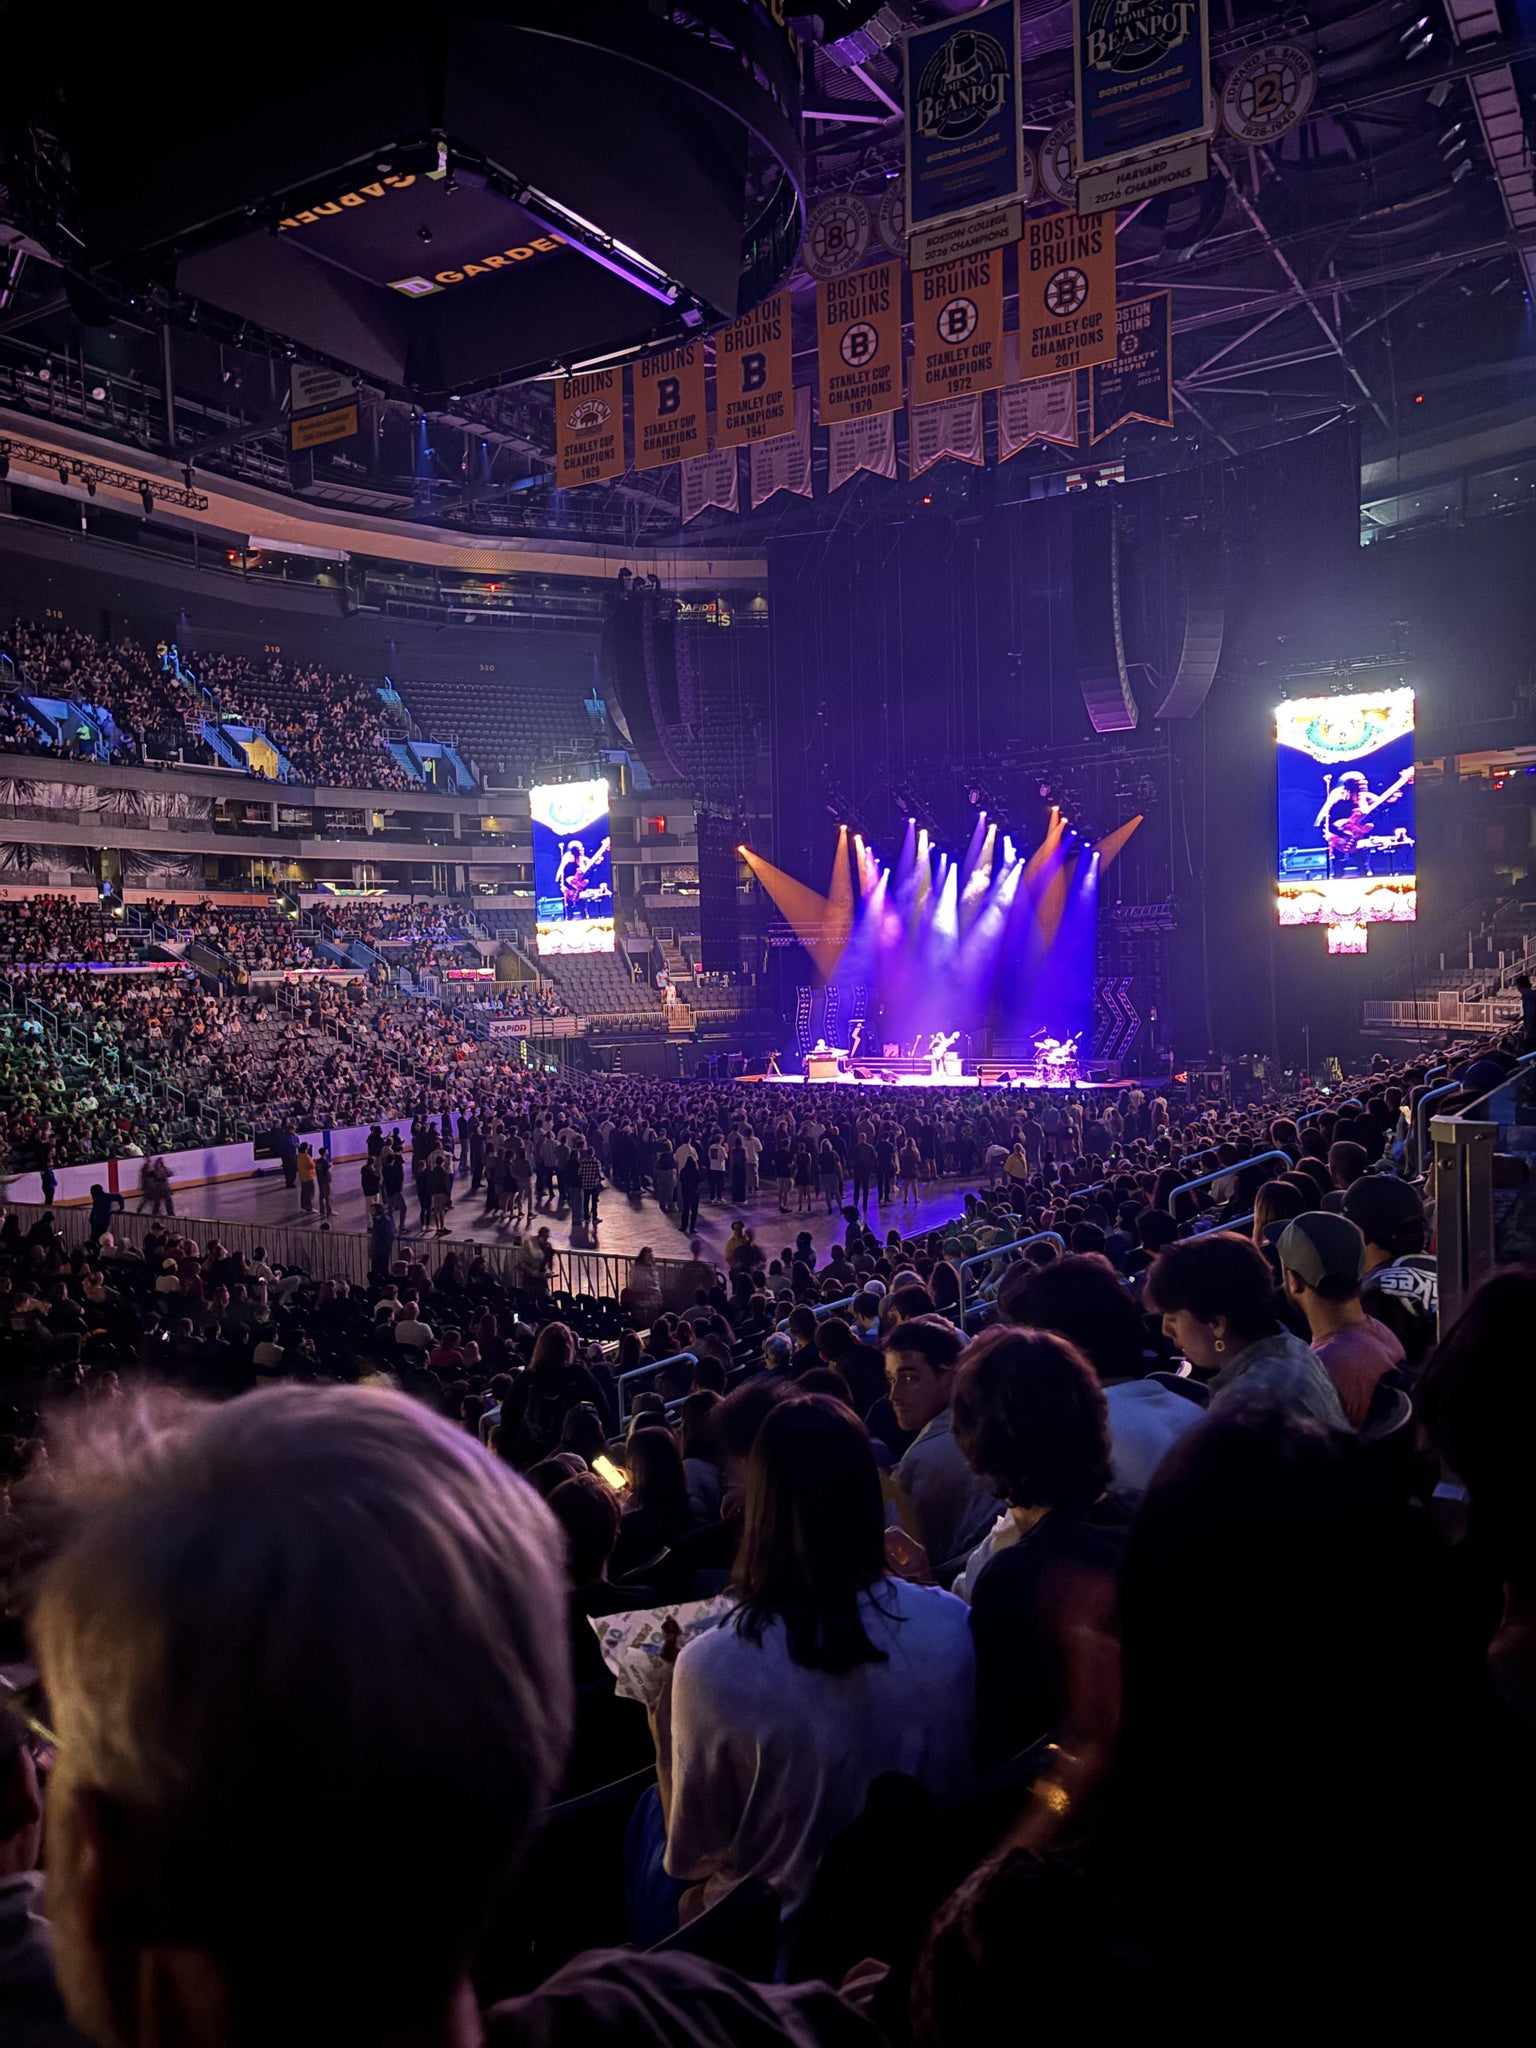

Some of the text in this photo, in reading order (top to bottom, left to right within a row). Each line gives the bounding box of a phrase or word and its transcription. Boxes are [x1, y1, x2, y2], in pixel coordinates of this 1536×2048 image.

[1085, 3, 1195, 69] BEANPOT
[916, 74, 1011, 133] BEANPOT
[1259, 80, 1277, 108] 2
[1095, 167, 1192, 205] 2026 CHAMPIONS
[1116, 161, 1168, 185] HARVARD
[828, 226, 843, 249] 8
[925, 227, 1010, 260] 2026 CHAMPIONS
[926, 214, 1008, 247] BOSTON COLLEGE
[1030, 213, 1102, 246] BOSTON
[1031, 230, 1102, 271] BRUINS
[827, 267, 890, 303] BOSTON
[924, 263, 990, 301] BRUINS
[828, 290, 890, 326] BRUINS
[725, 319, 781, 353] BRUINS
[1032, 313, 1103, 342] STANLEY CUP
[927, 342, 991, 369] STANLEY CUP
[1031, 329, 1104, 358] CHAMPIONS
[642, 345, 694, 378] BRUINS
[926, 356, 993, 384] CHAMPIONS
[1055, 351, 1080, 369] 2011
[1113, 360, 1146, 375] TROPHY
[563, 369, 613, 400] BRUINS
[829, 365, 891, 390] STANLEY CUP
[947, 376, 972, 393] 1972
[726, 391, 783, 415] STANLEY CUP
[829, 380, 892, 405] CHAMPIONS
[850, 399, 873, 414] 1970
[566, 399, 611, 428] BOSTON
[644, 414, 696, 438] STANLEY CUP
[726, 405, 784, 429] CHAMPIONS
[643, 428, 697, 451] CHAMPIONS
[745, 423, 766, 439] 1941
[564, 435, 615, 457] STANLEY CUP
[564, 448, 616, 470] CHAMPIONS
